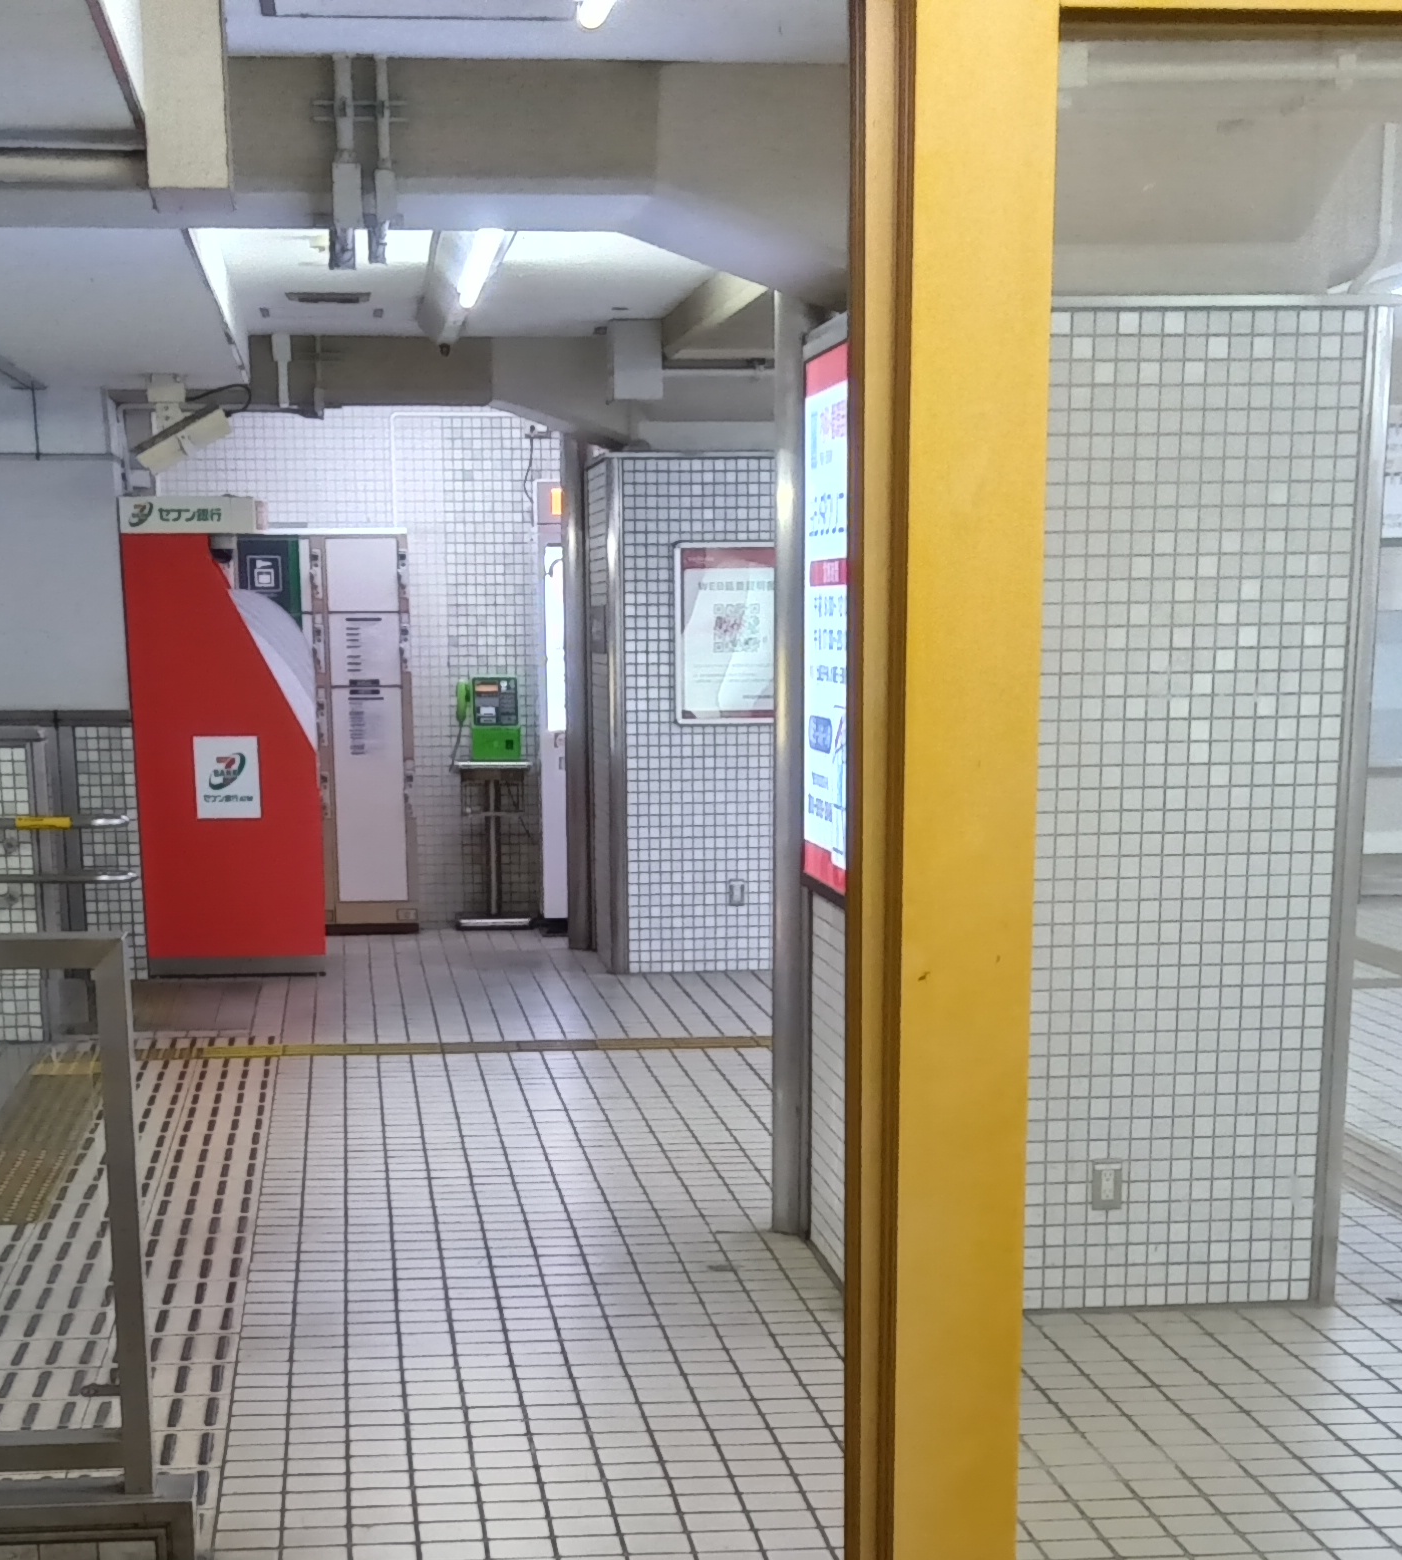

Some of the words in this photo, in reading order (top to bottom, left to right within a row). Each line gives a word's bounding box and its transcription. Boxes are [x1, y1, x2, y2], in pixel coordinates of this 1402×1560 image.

[157, 507, 222, 522] セブン銀行
